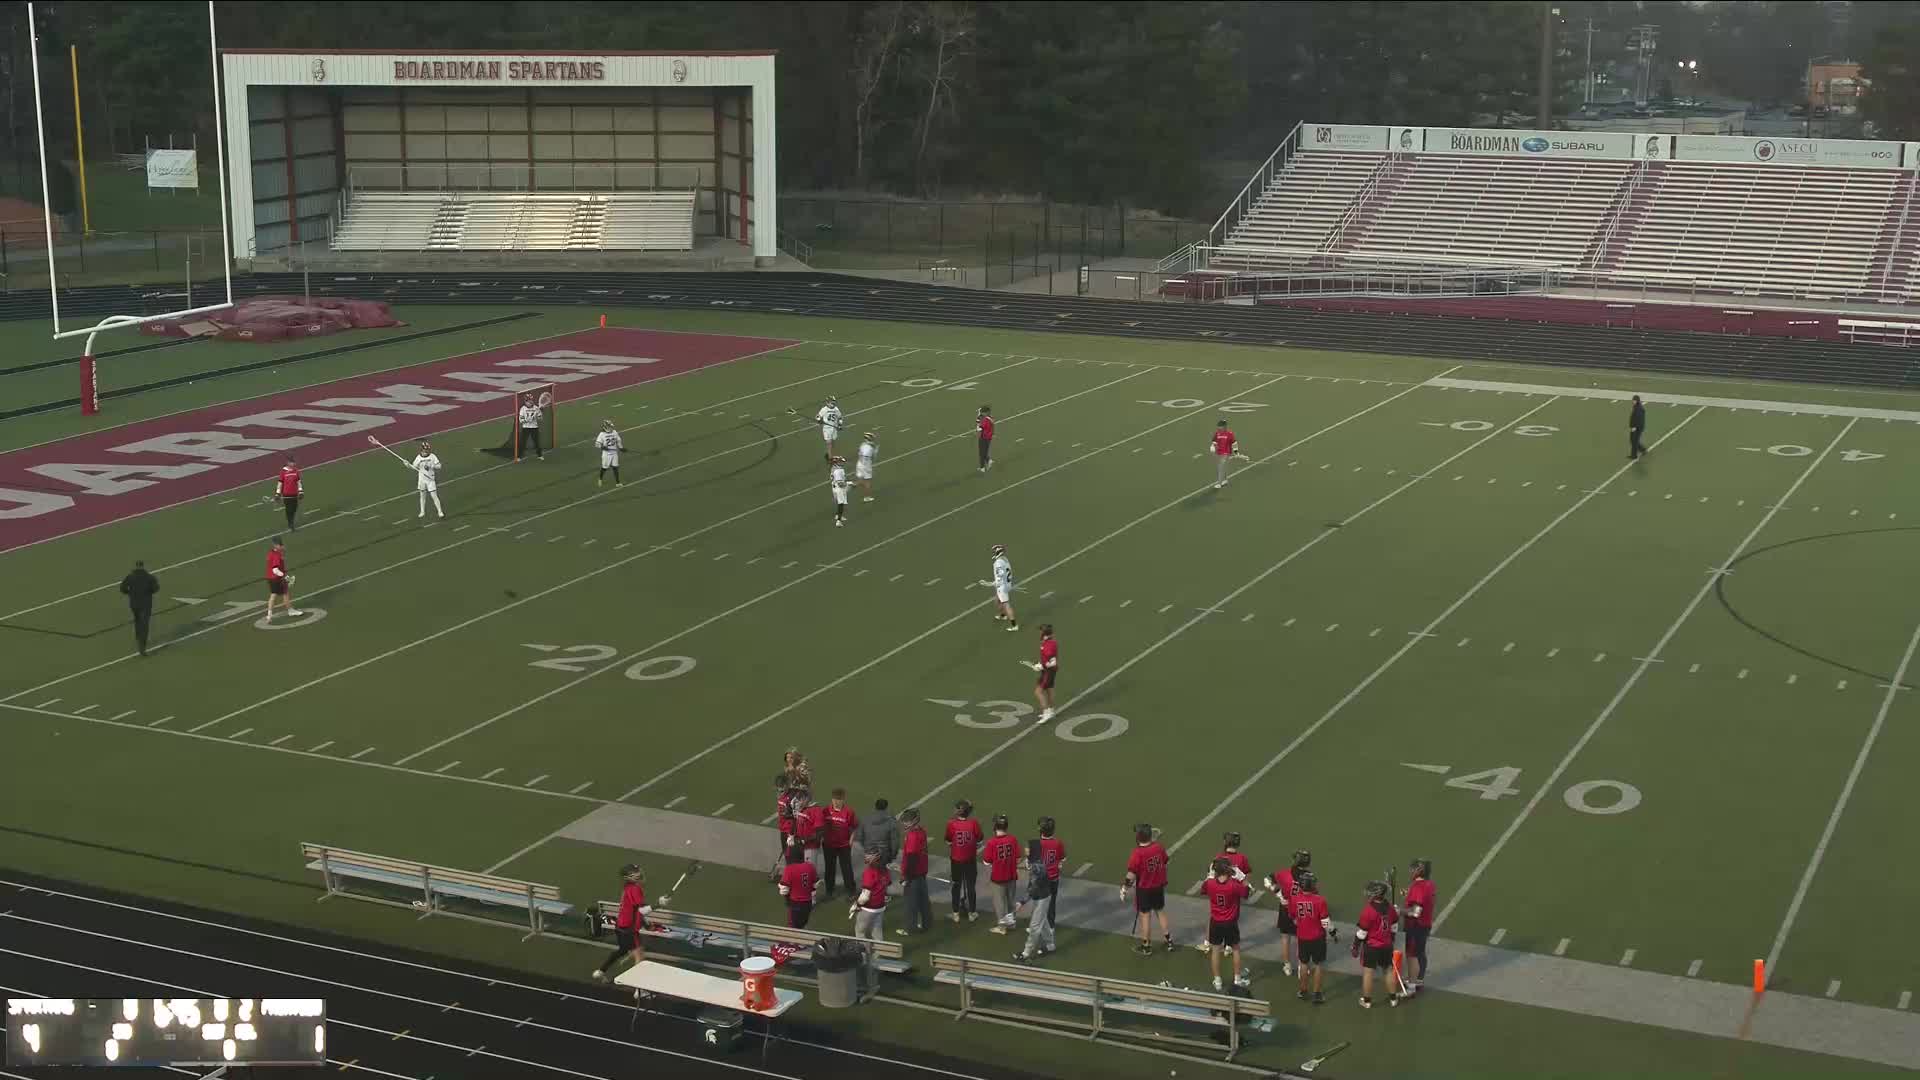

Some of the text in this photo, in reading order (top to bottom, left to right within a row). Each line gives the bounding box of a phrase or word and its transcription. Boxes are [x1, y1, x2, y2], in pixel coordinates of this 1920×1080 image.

[394, 61, 605, 81] BOARDMAN SPARTANS
[1451, 134, 1605, 152] BOARDMAN SUBARU
[1297, 901, 1314, 918] 24
[744, 979, 756, 991] G
